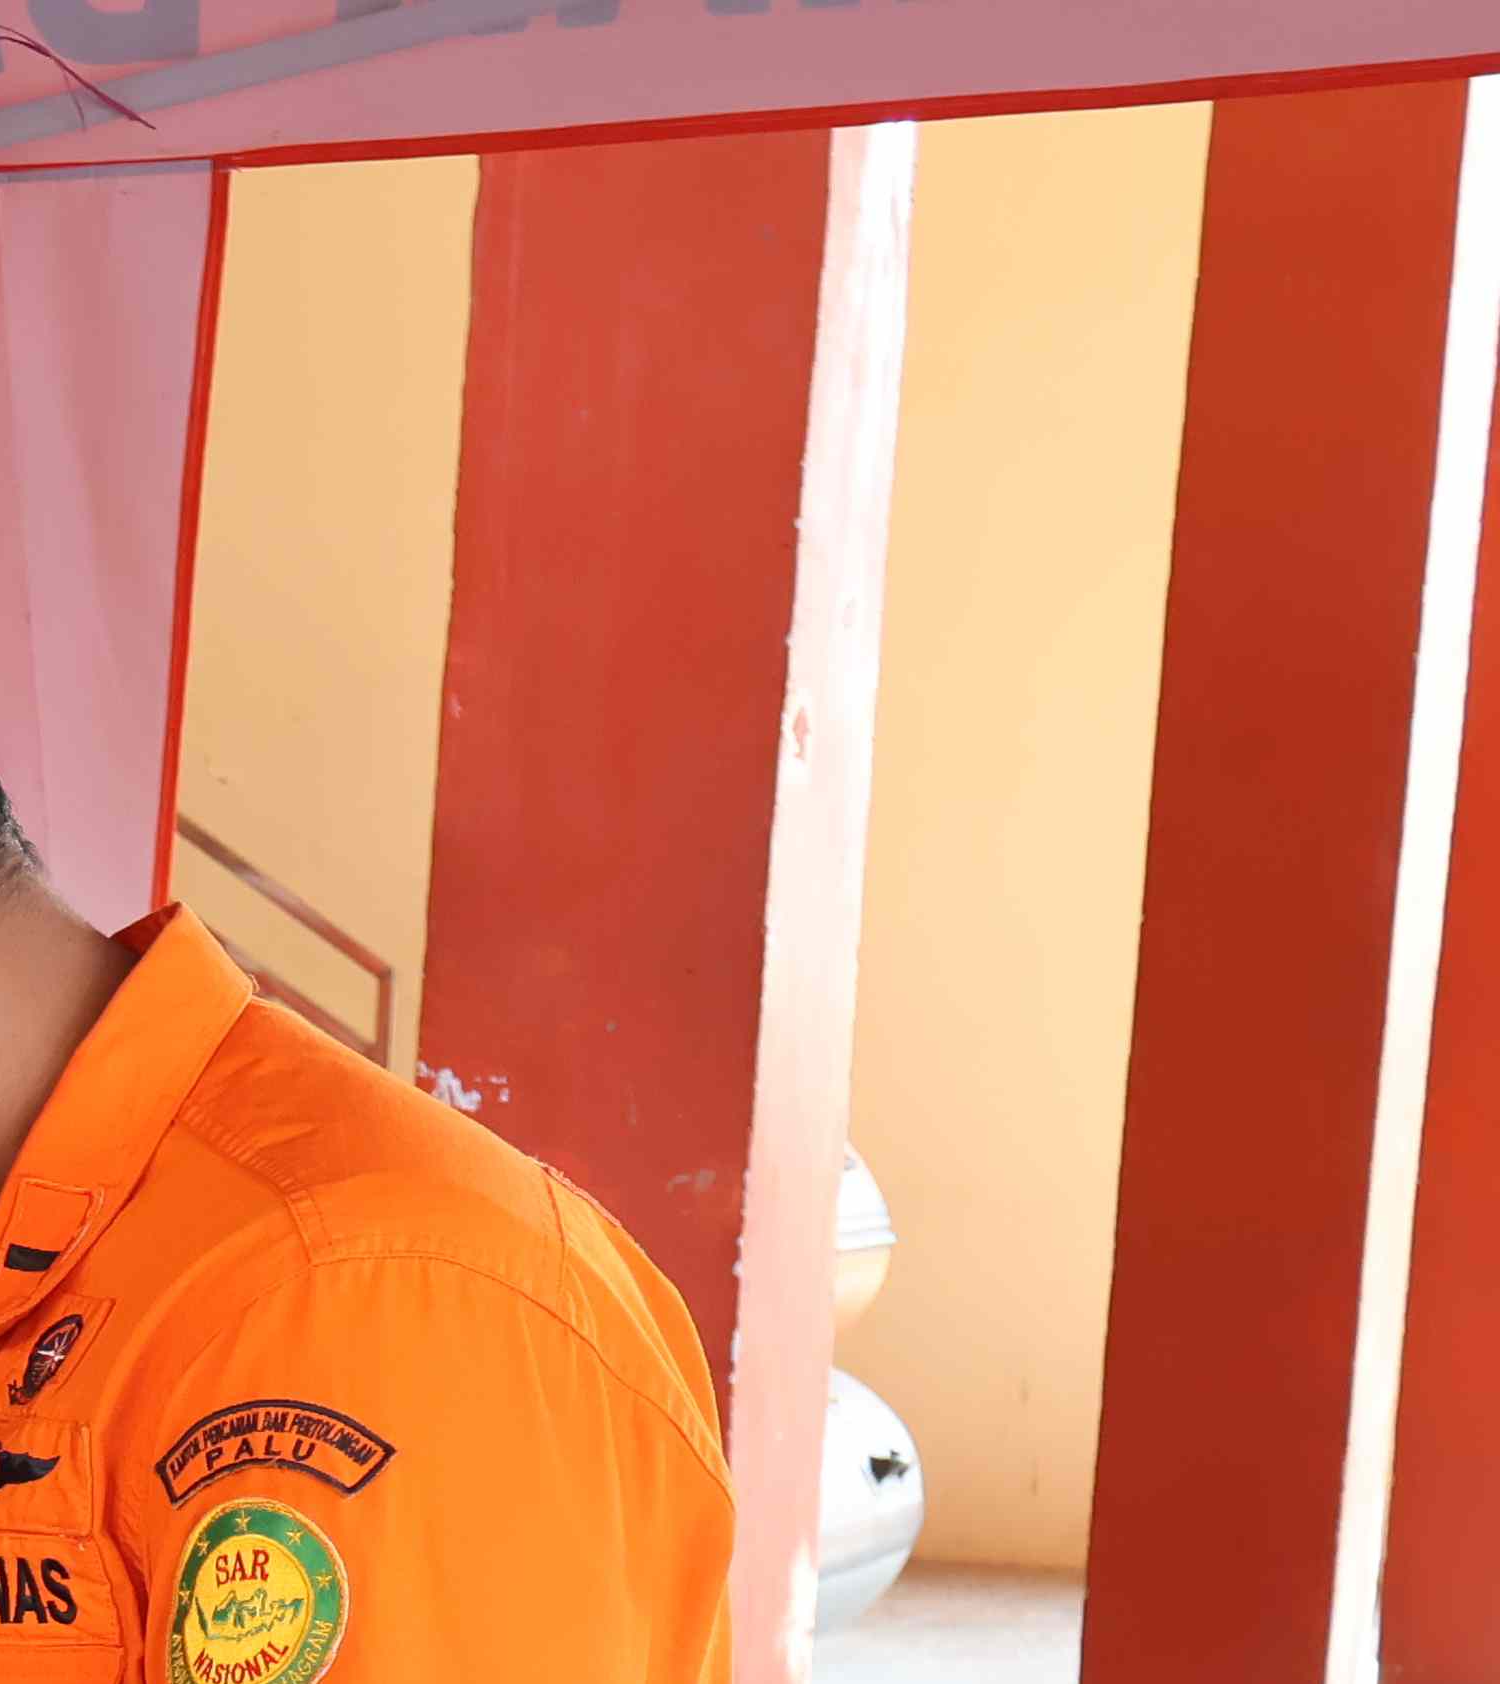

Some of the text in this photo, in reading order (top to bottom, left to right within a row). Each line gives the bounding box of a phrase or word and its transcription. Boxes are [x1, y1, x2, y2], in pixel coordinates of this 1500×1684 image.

[263, 1411, 289, 1433] DAN
[205, 1436, 316, 1471] PALU
[215, 1549, 269, 1587] SAR
